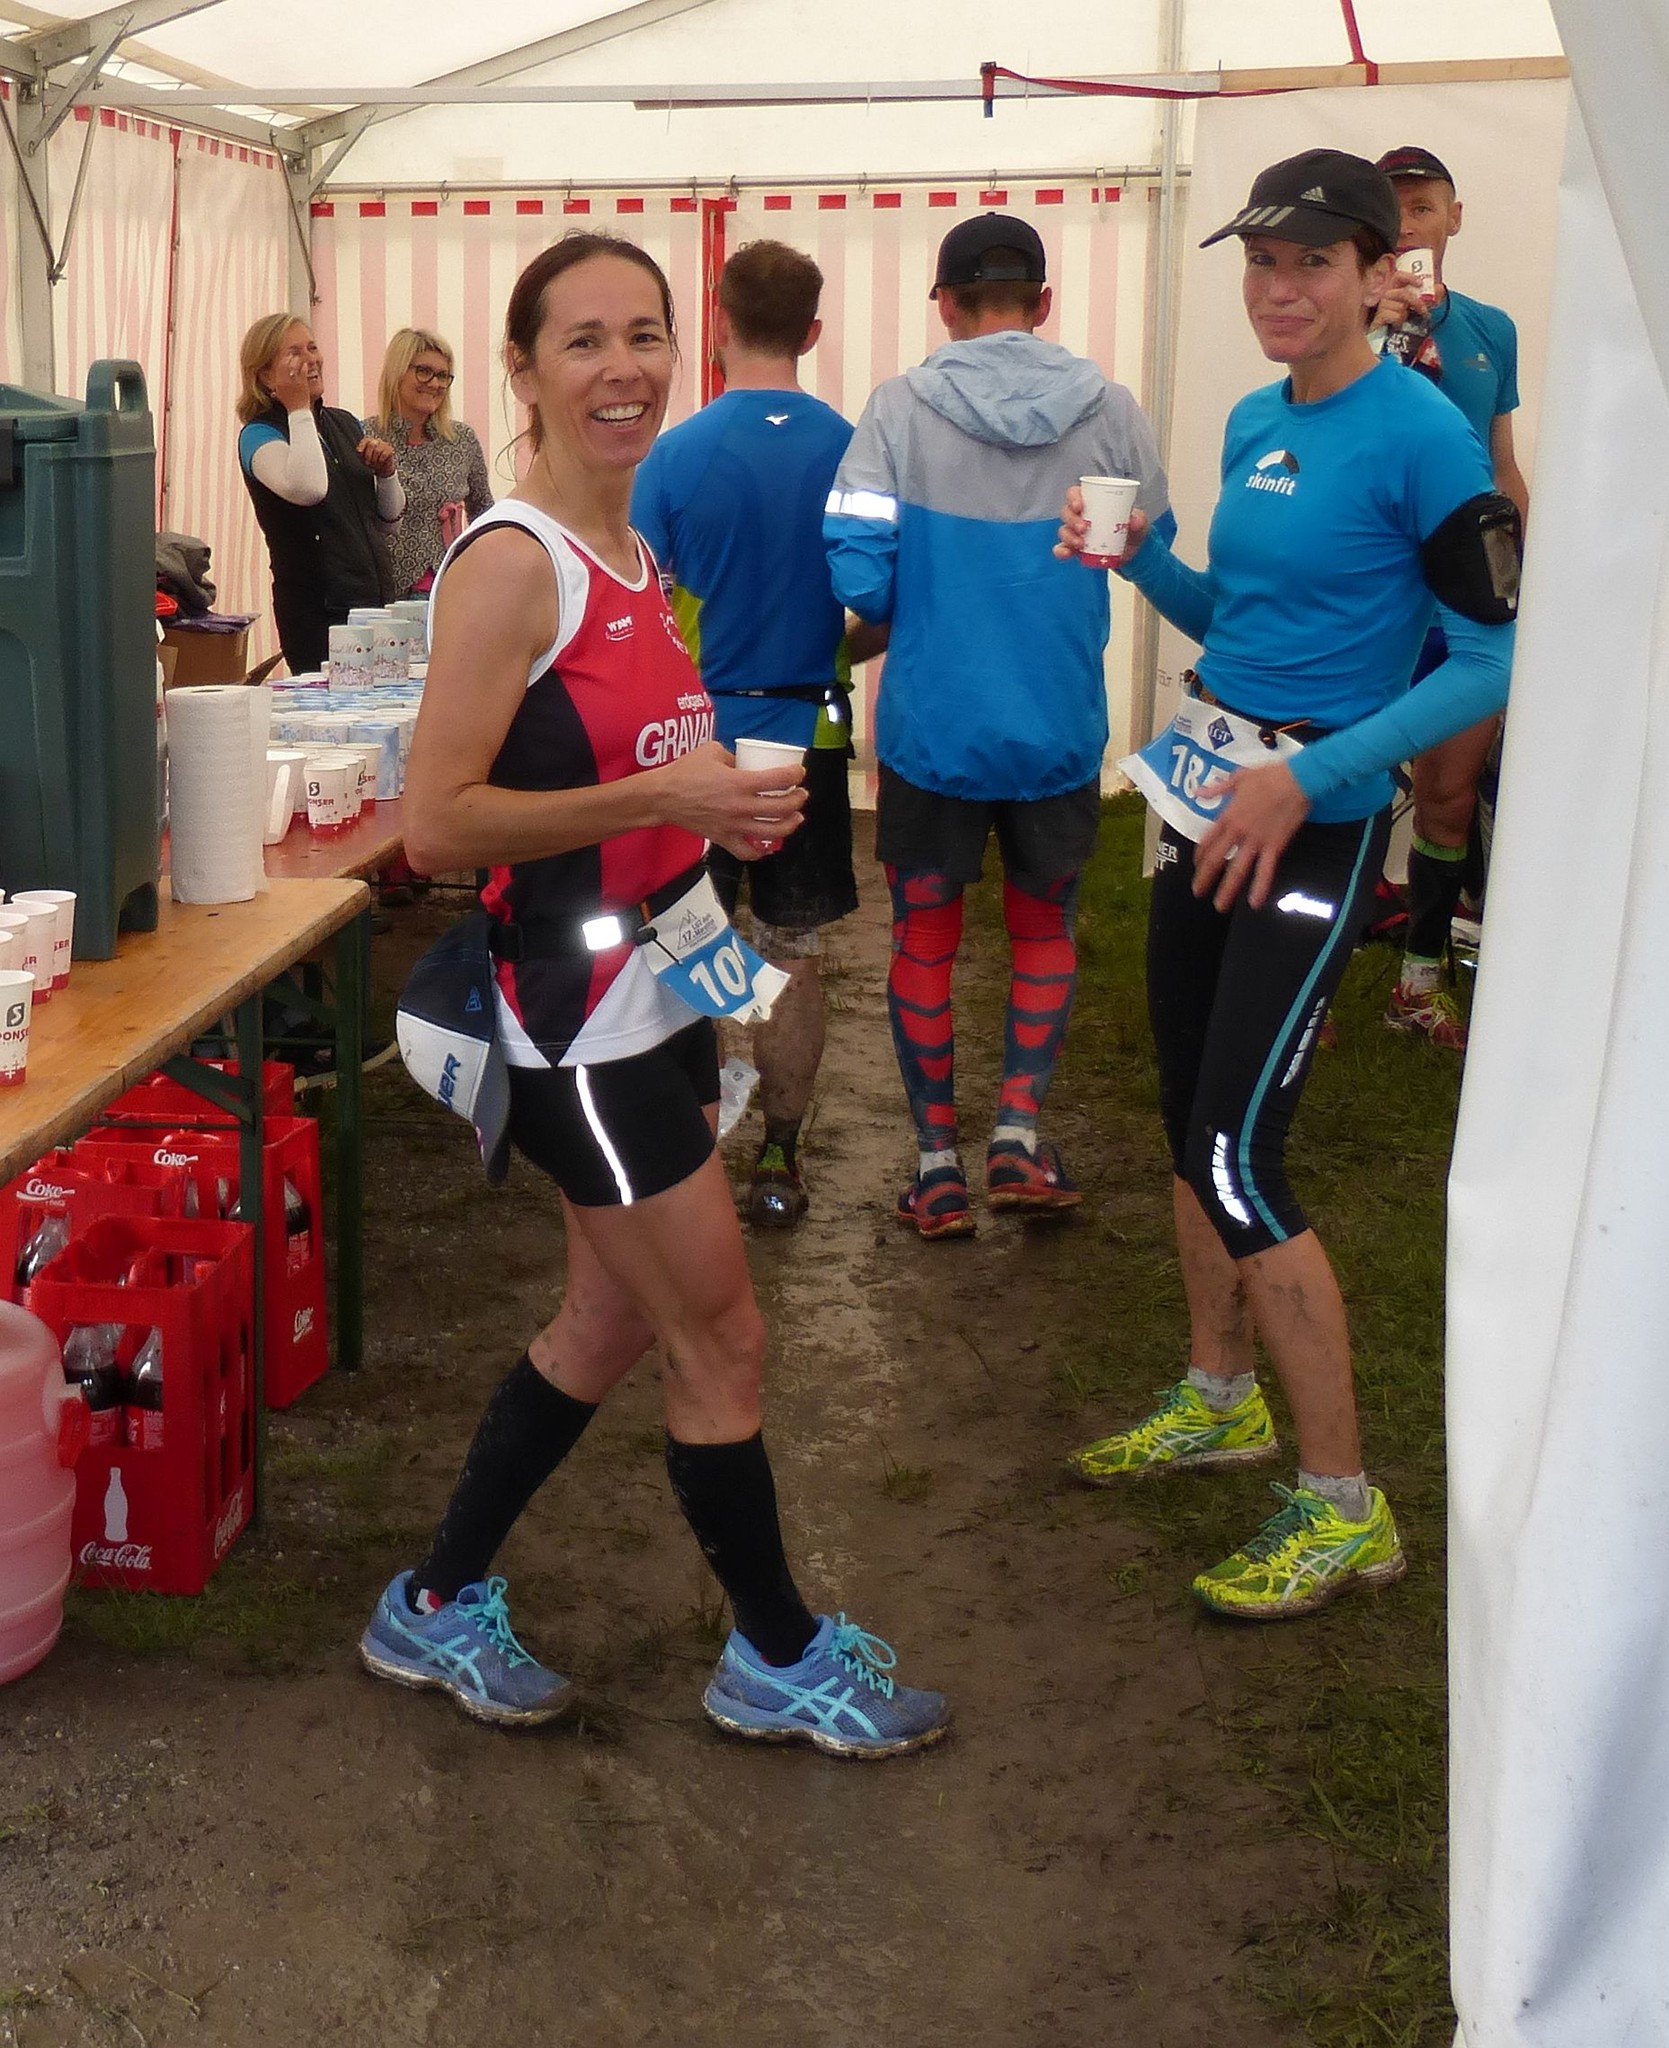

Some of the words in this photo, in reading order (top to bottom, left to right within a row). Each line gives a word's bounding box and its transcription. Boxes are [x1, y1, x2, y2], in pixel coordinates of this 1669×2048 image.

[1245, 472, 1296, 496] skinfit
[154, 1149, 190, 1166] Coke
[26, 1178, 66, 1198] Coke
